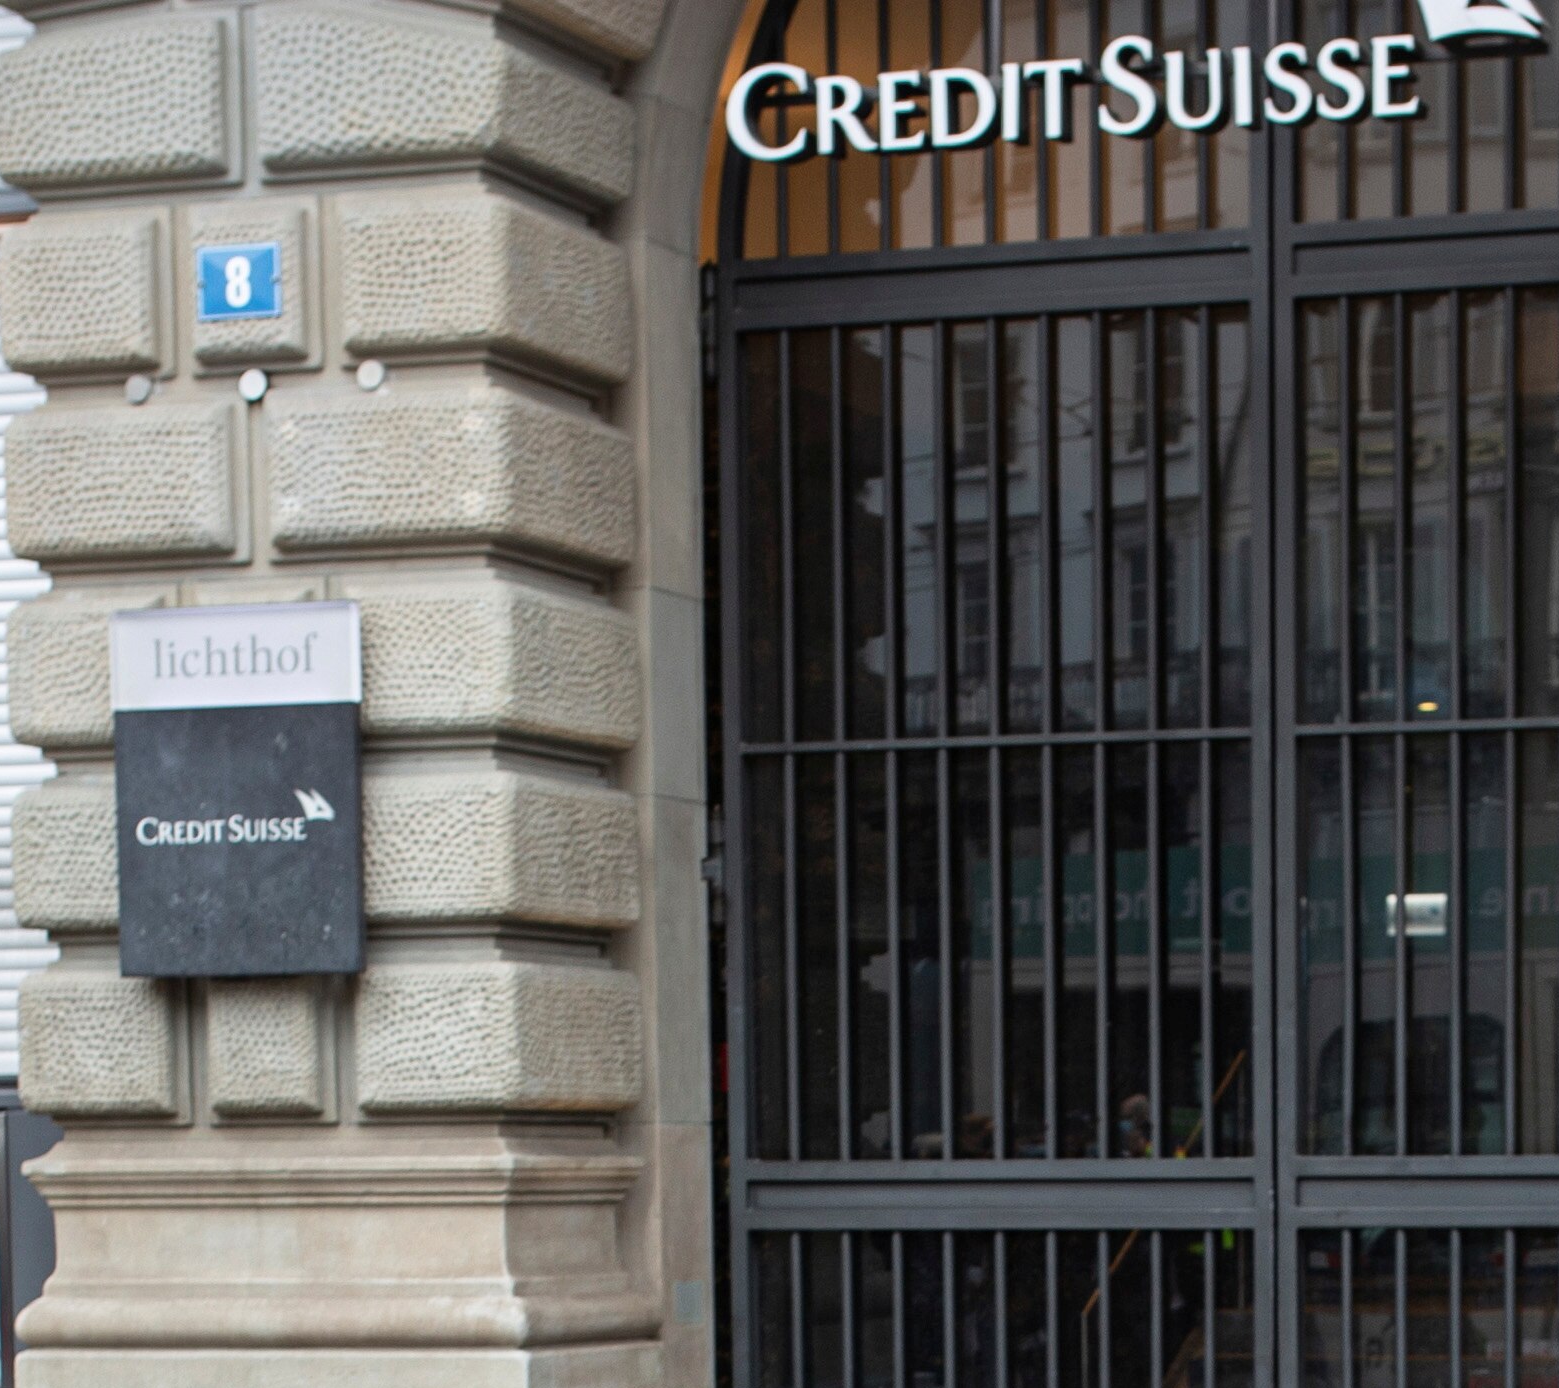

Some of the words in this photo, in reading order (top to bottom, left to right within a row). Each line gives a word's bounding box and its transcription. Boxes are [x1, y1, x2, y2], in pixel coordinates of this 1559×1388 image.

[725, 58, 1082, 162] CREDIT
[1097, 34, 1422, 138] SUISSE
[224, 255, 251, 308] 8
[153, 632, 318, 679] lichthof
[136, 817, 226, 846] CREDIT
[227, 814, 308, 843] SUISSE
